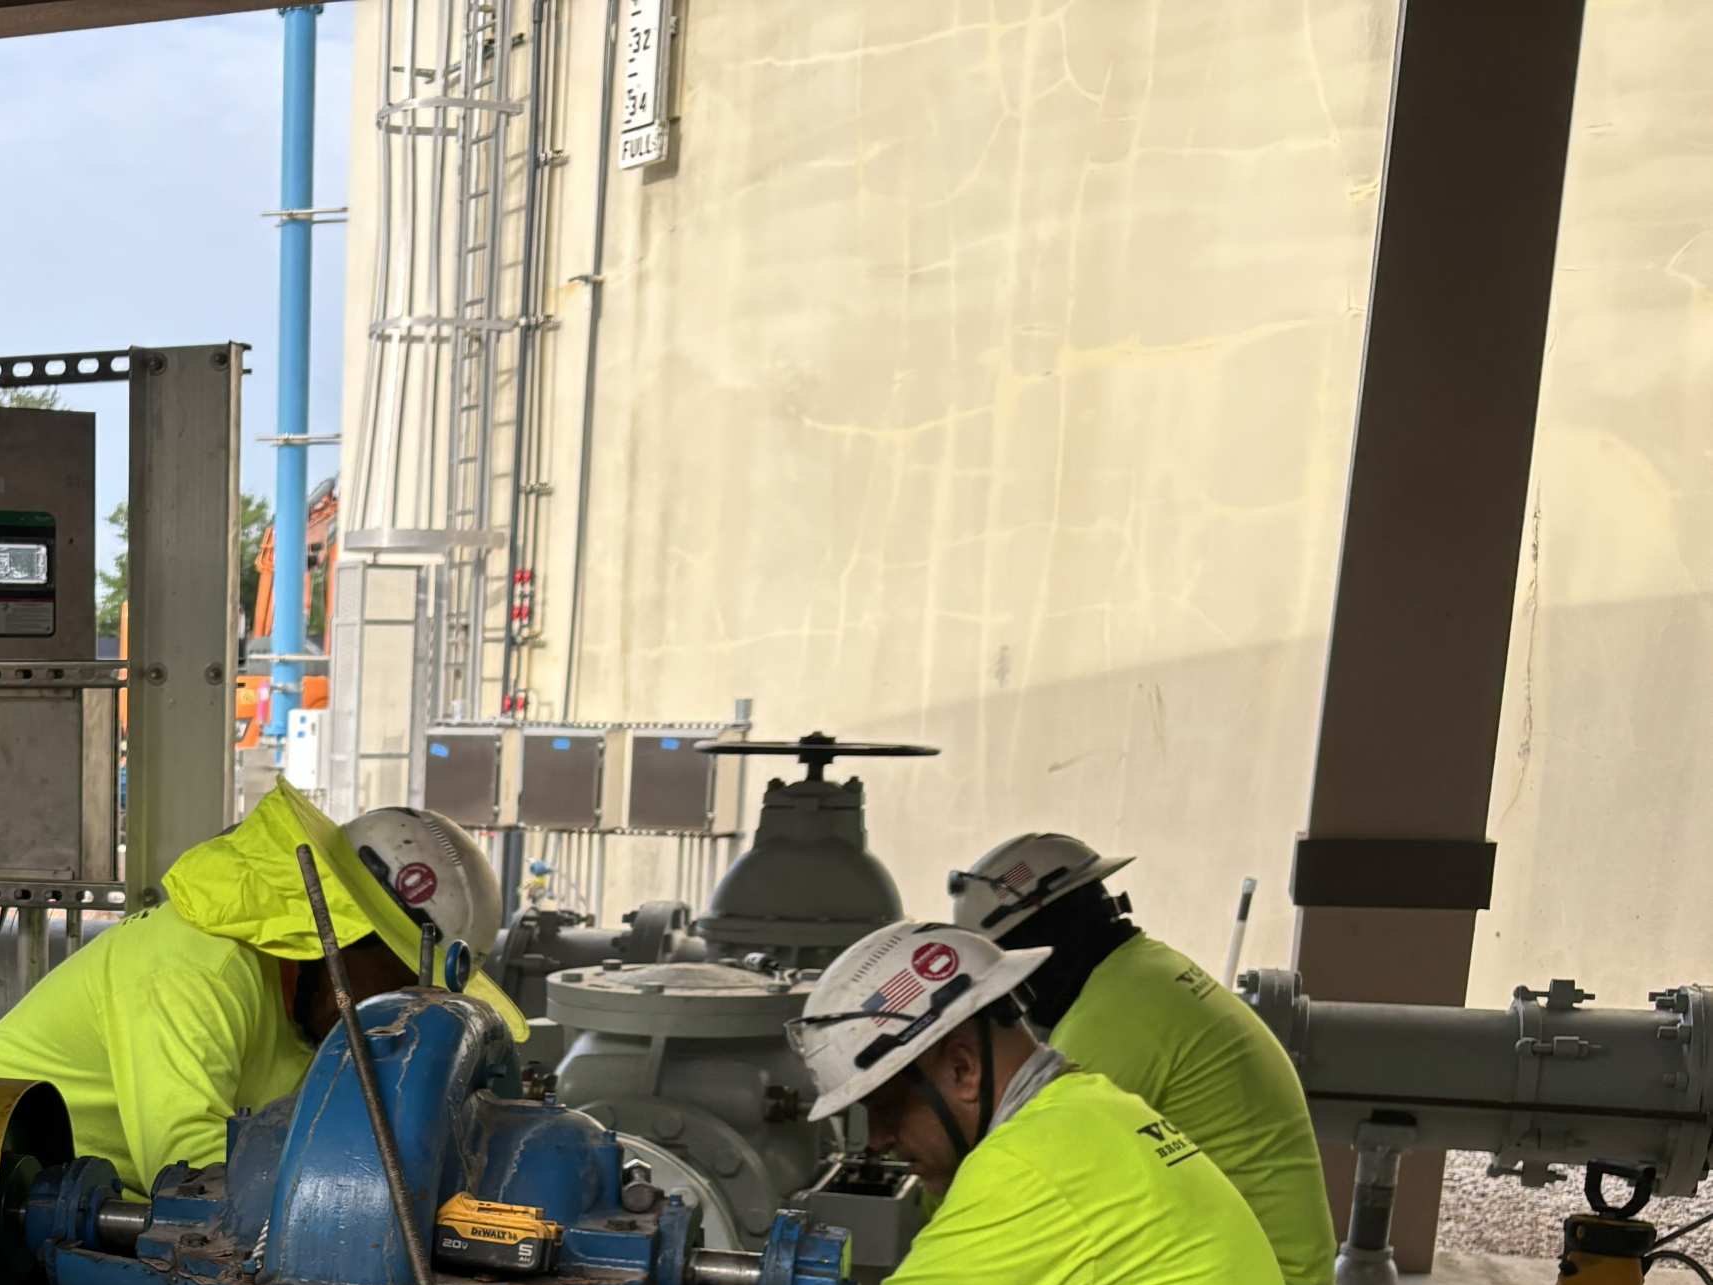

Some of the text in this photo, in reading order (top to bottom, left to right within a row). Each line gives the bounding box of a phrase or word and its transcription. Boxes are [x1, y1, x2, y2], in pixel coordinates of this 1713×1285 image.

[632, 28, 651, 54] 32
[621, 133, 653, 161] FULL
[517, 1244, 534, 1257] 5
